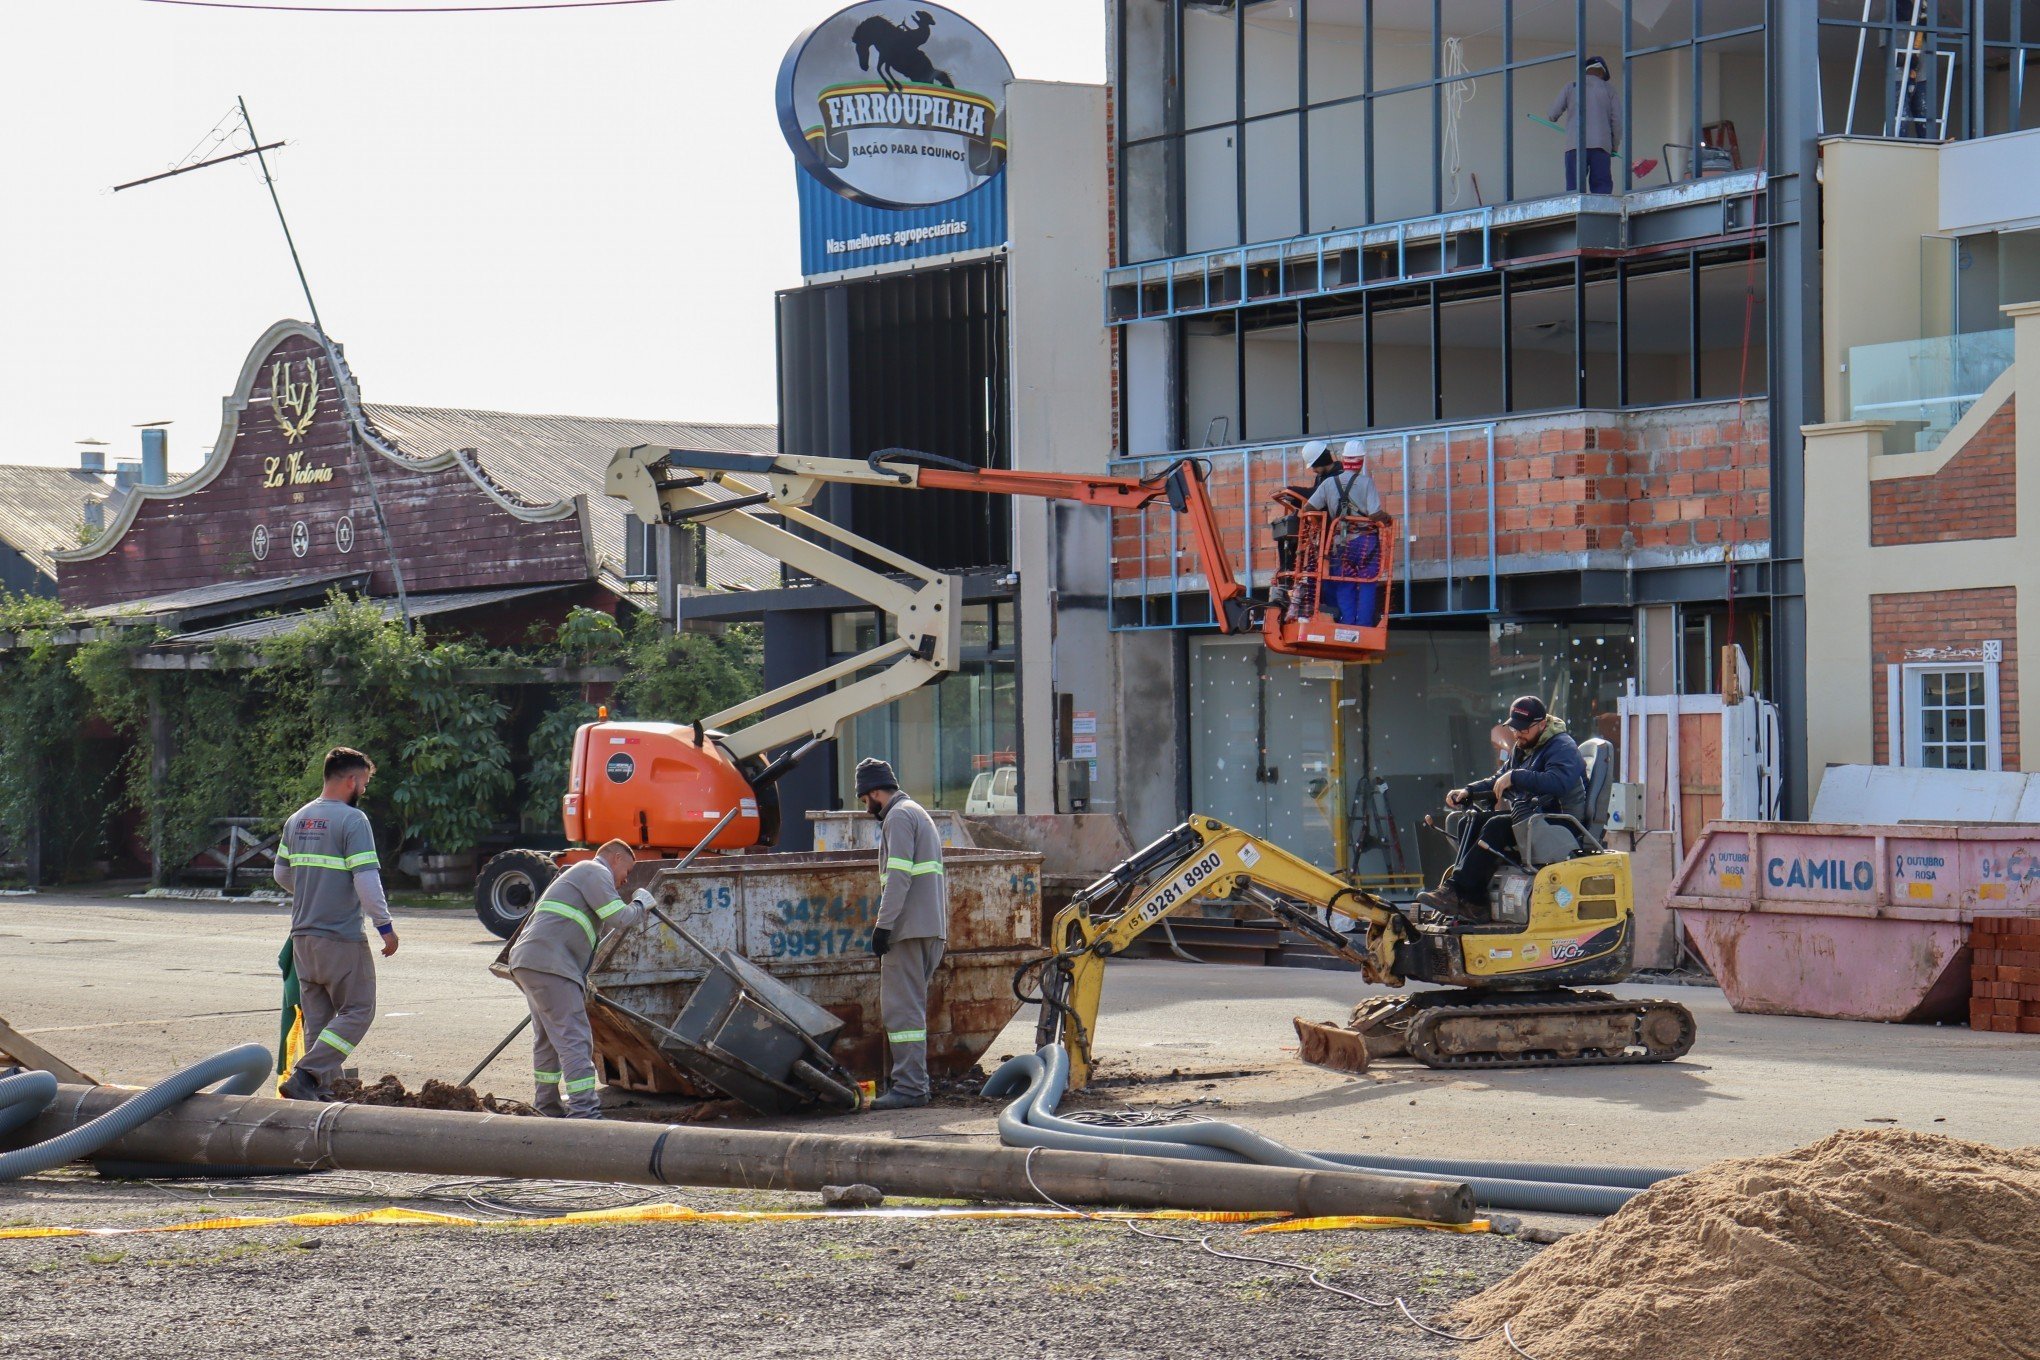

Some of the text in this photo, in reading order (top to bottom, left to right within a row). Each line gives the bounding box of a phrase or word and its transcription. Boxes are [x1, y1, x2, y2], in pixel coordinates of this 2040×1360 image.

[826, 92, 985, 136] FARROUPILHA
[852, 141, 966, 162] RAÇÃO PARA EQUINOS
[826, 219, 967, 254] Nas melhores agropecuárias
[263, 450, 333, 489] La Victoria
[1718, 852, 1749, 863] OUTUBR
[1907, 856, 1945, 867] OUTUBRO
[1725, 865, 1745, 876] ROSA
[1767, 857, 1874, 891] CAMILO
[1915, 870, 1937, 880] ROSA
[1009, 872, 1037, 896] 15
[1128, 911, 1149, 930] (51)
[1146, 882, 1184, 917] 9281
[1184, 852, 1221, 888] 8980
[703, 886, 731, 909] 15
